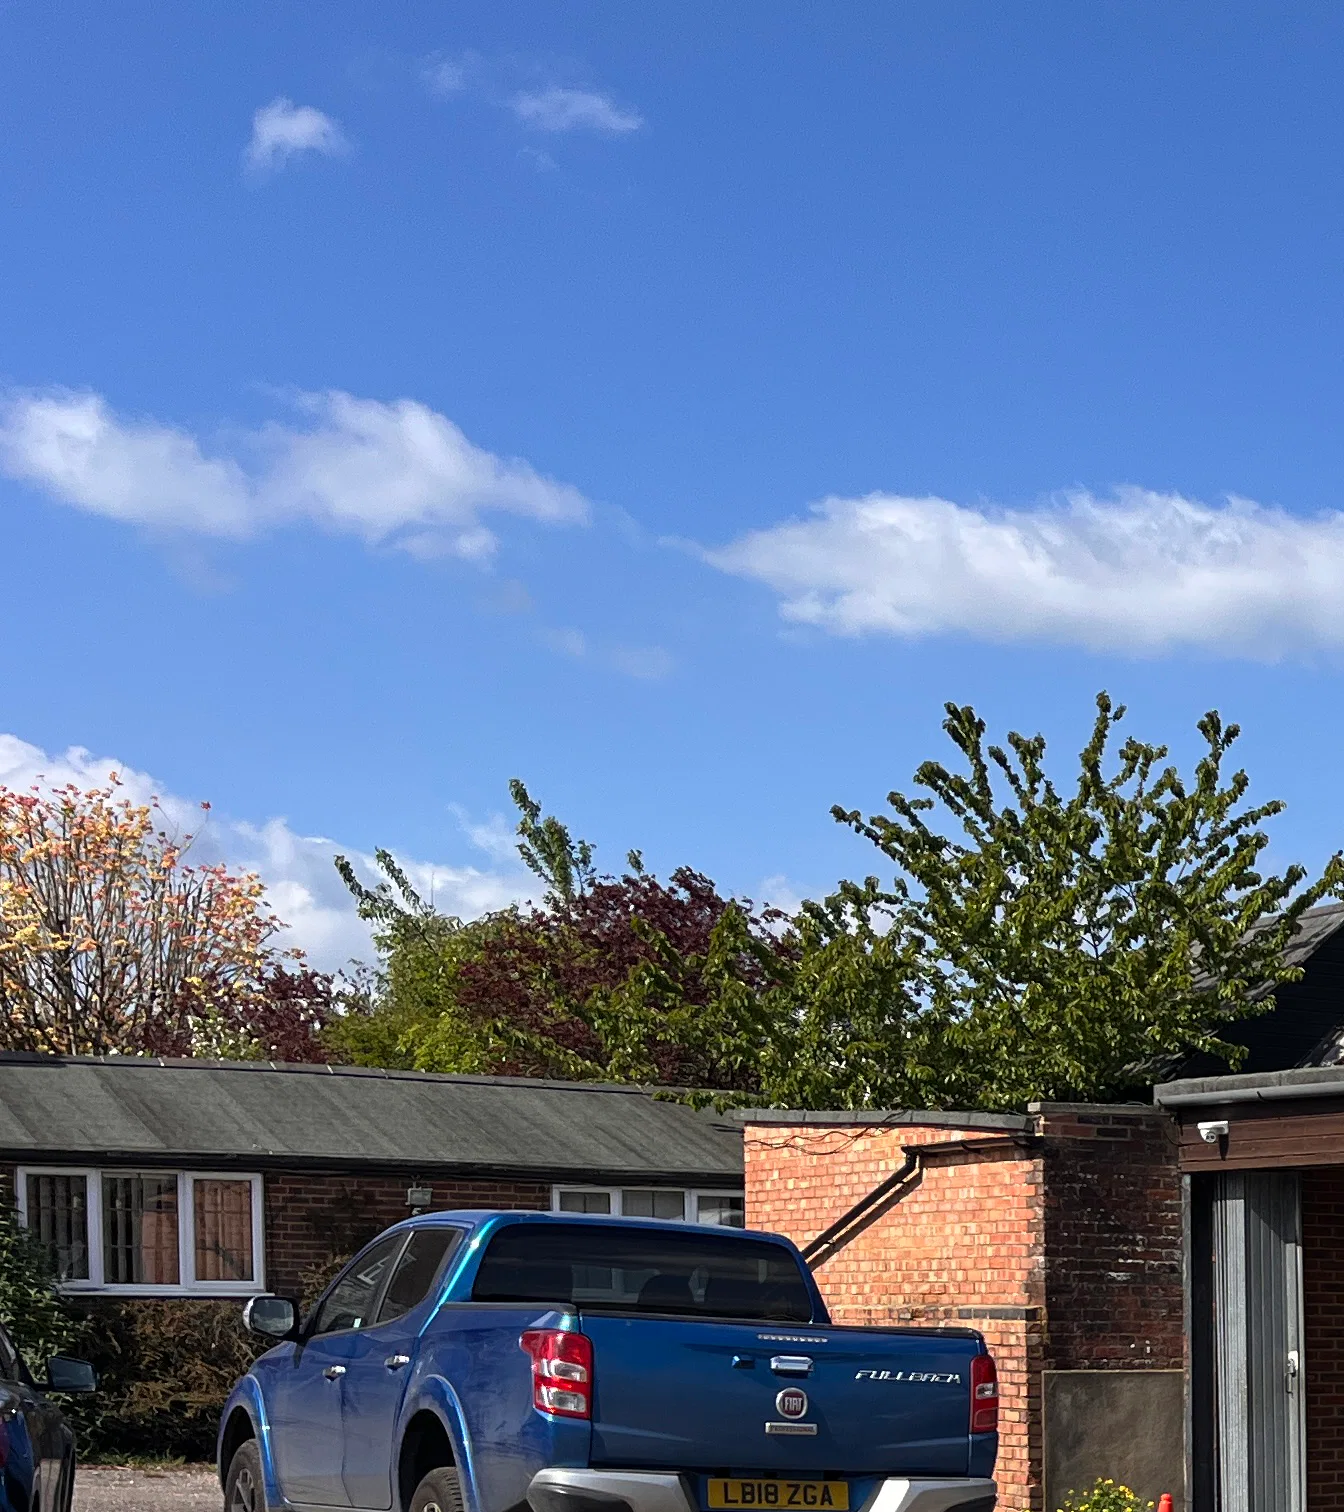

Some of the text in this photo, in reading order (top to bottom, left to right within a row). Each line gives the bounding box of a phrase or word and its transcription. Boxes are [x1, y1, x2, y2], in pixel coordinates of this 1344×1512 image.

[855, 1370, 961, 1384] FULLBACK
[784, 1396, 803, 1411] FIAT
[723, 1482, 833, 1506] LB18 ZGA
